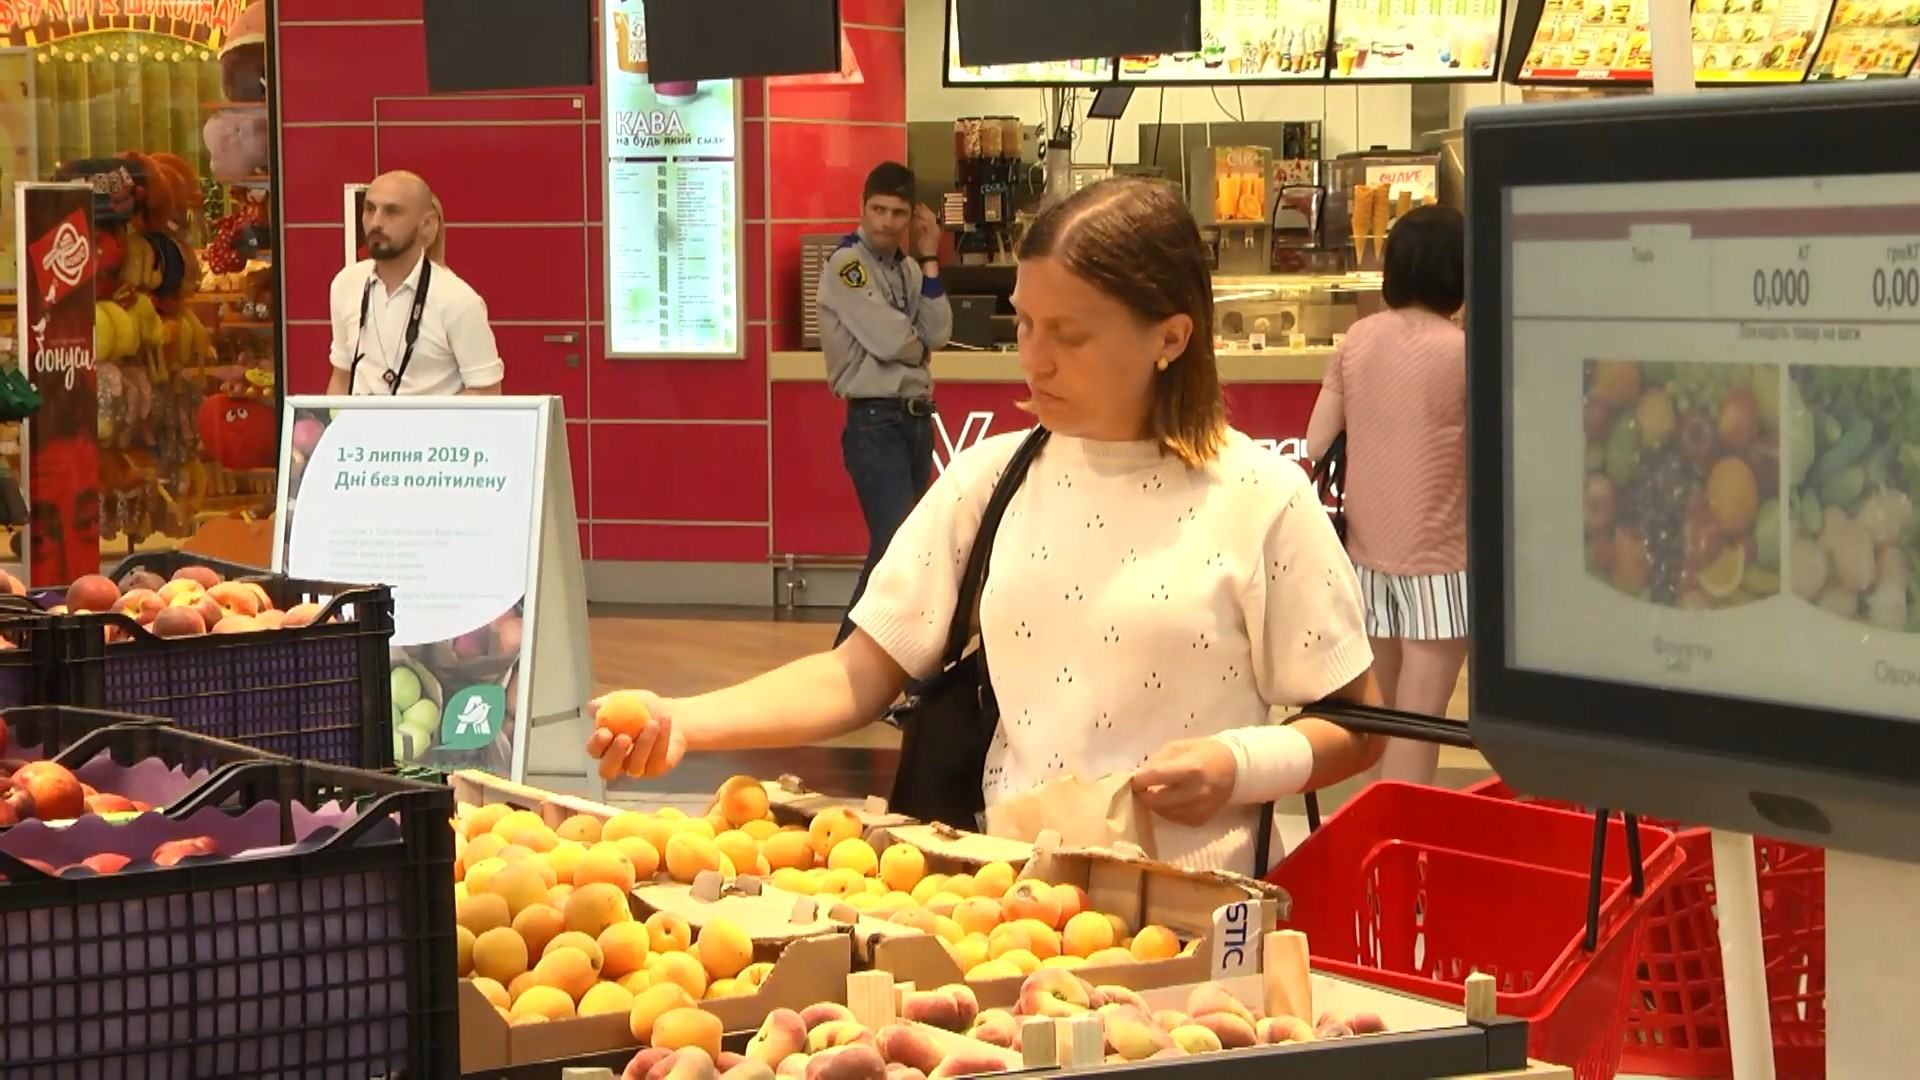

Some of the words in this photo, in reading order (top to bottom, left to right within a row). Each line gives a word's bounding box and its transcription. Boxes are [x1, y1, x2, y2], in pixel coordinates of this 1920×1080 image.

[615, 111, 684, 137] КАВА
[616, 136, 630, 147] на
[633, 133, 660, 149] будь
[664, 132, 692, 146] який
[1753, 268, 1810, 312] 0,000
[34, 325, 97, 391] бонуси!
[336, 447, 364, 463] 1-3
[368, 450, 423, 463] липня
[427, 447, 470, 463] 2019
[473, 450, 489, 468] р.
[334, 470, 367, 490] Дні
[370, 471, 400, 487] без
[403, 471, 507, 492] політилену
